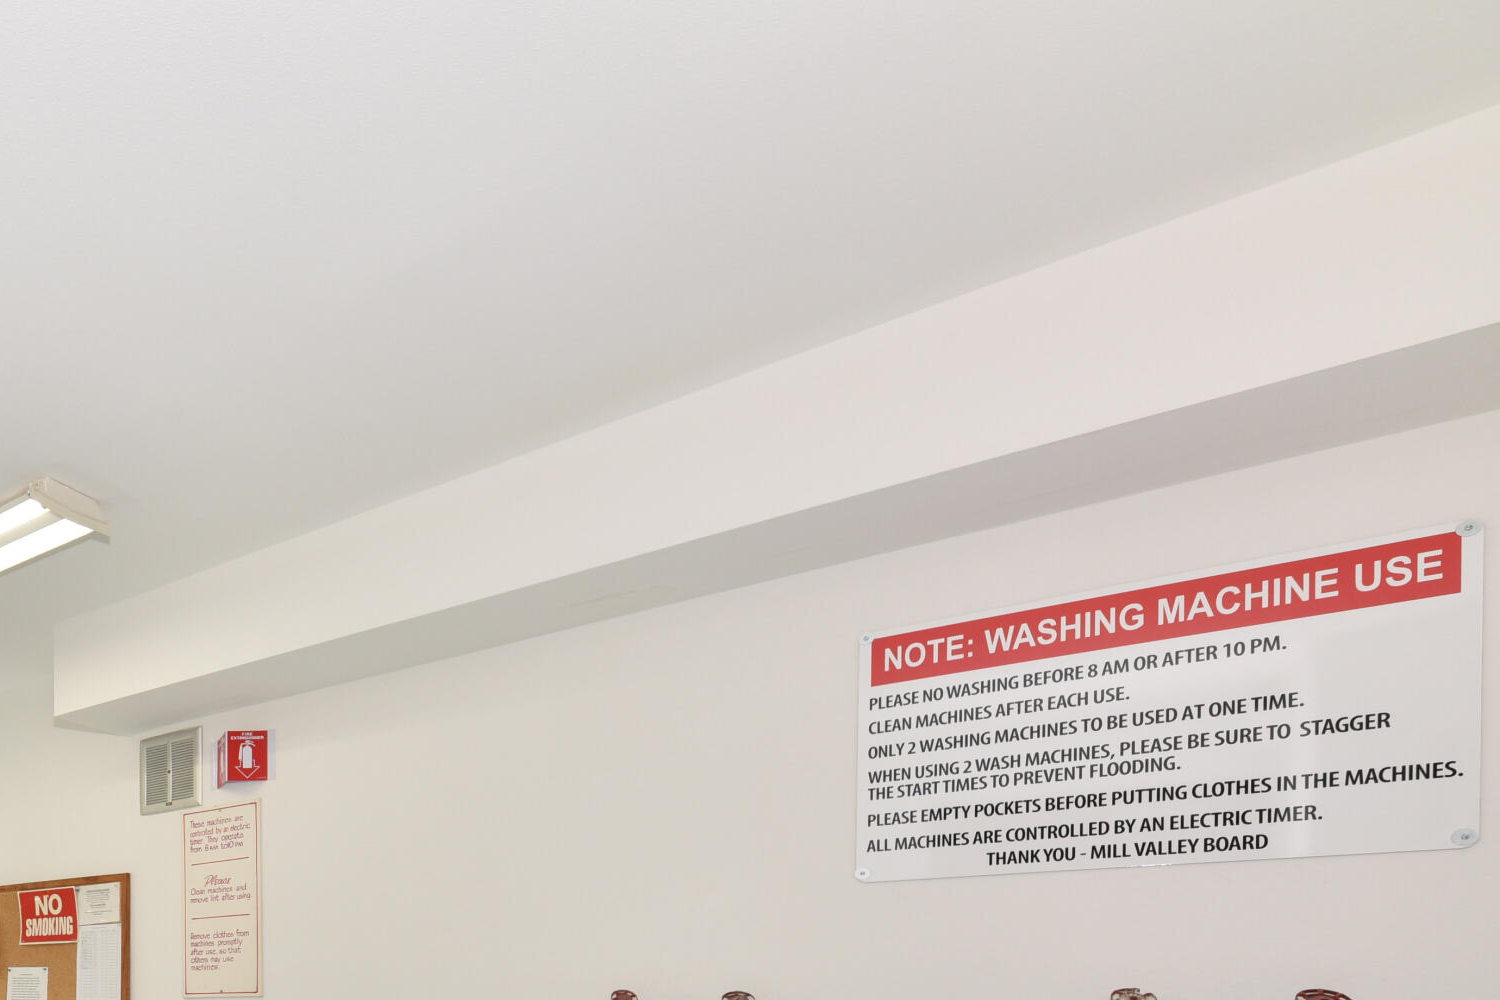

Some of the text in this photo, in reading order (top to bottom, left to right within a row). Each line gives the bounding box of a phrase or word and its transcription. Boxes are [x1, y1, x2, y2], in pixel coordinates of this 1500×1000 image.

[884, 549, 1443, 672] NOTE: WASHING MACHINE USE
[869, 635, 1287, 711] PLEASE NO WASHING BEFORE 8 AM OR AFTER 10 PM.
[868, 686, 1130, 735] CLEAN MACHINES AFTER EACH USE.
[868, 692, 1305, 760] ONLY 2 WASHING MACHINES TO BE USED AT ONE TIME.
[867, 712, 1391, 784] WHEN USING 2 WASH MACHINES, PLEASE BE SURE TO STAGGER
[867, 755, 1181, 801] THE START TIMES TO PREVENT FLOODING.
[867, 760, 1464, 827] PLEASE EMPTY POCKETS BEFORE PUTTING CLOTHES IN THE MACHINES.
[207, 816, 231, 826] machines
[866, 804, 1323, 853] ALL MACHINES ARE CONTROLLED BY AN ELECTRIC TIMER.
[986, 849, 1041, 866] THANK
[1042, 846, 1076, 863] YOU
[1090, 843, 1132, 860] MILL
[1133, 838, 1200, 857] VALLEY
[1203, 833, 1269, 853] BOARD
[25, 916, 74, 937] SMOKING
[34, 894, 62, 916] NO
[218, 938, 243, 947] promptly
